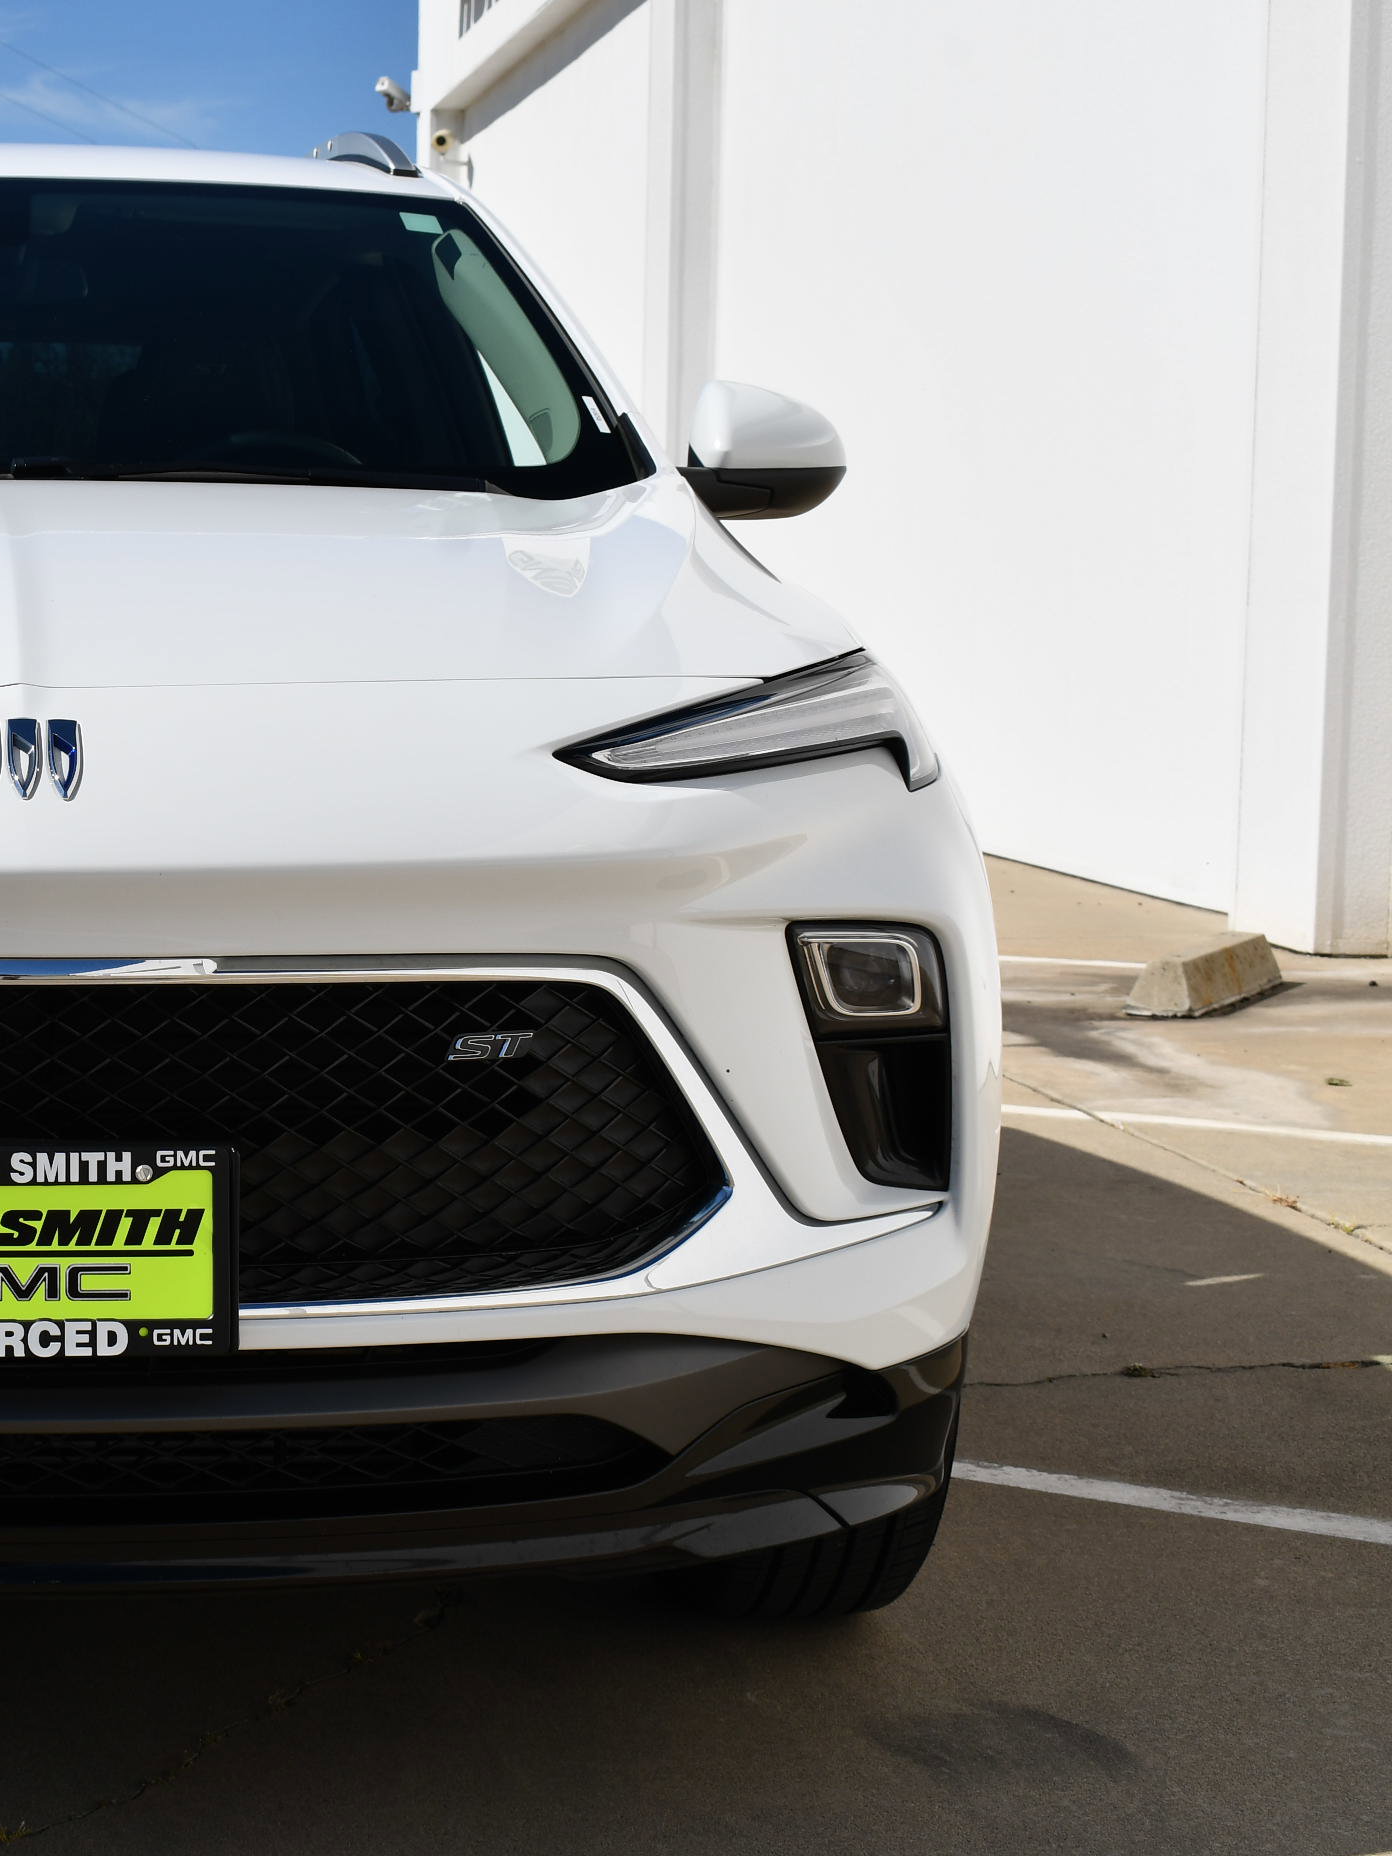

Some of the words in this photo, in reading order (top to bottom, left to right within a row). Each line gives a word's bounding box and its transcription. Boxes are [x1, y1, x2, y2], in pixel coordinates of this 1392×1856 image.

[448, 1033, 533, 1060] ST
[10, 1151, 132, 1182] SMITH
[155, 1150, 216, 1167] GMC
[152, 1328, 213, 1345] GMC
